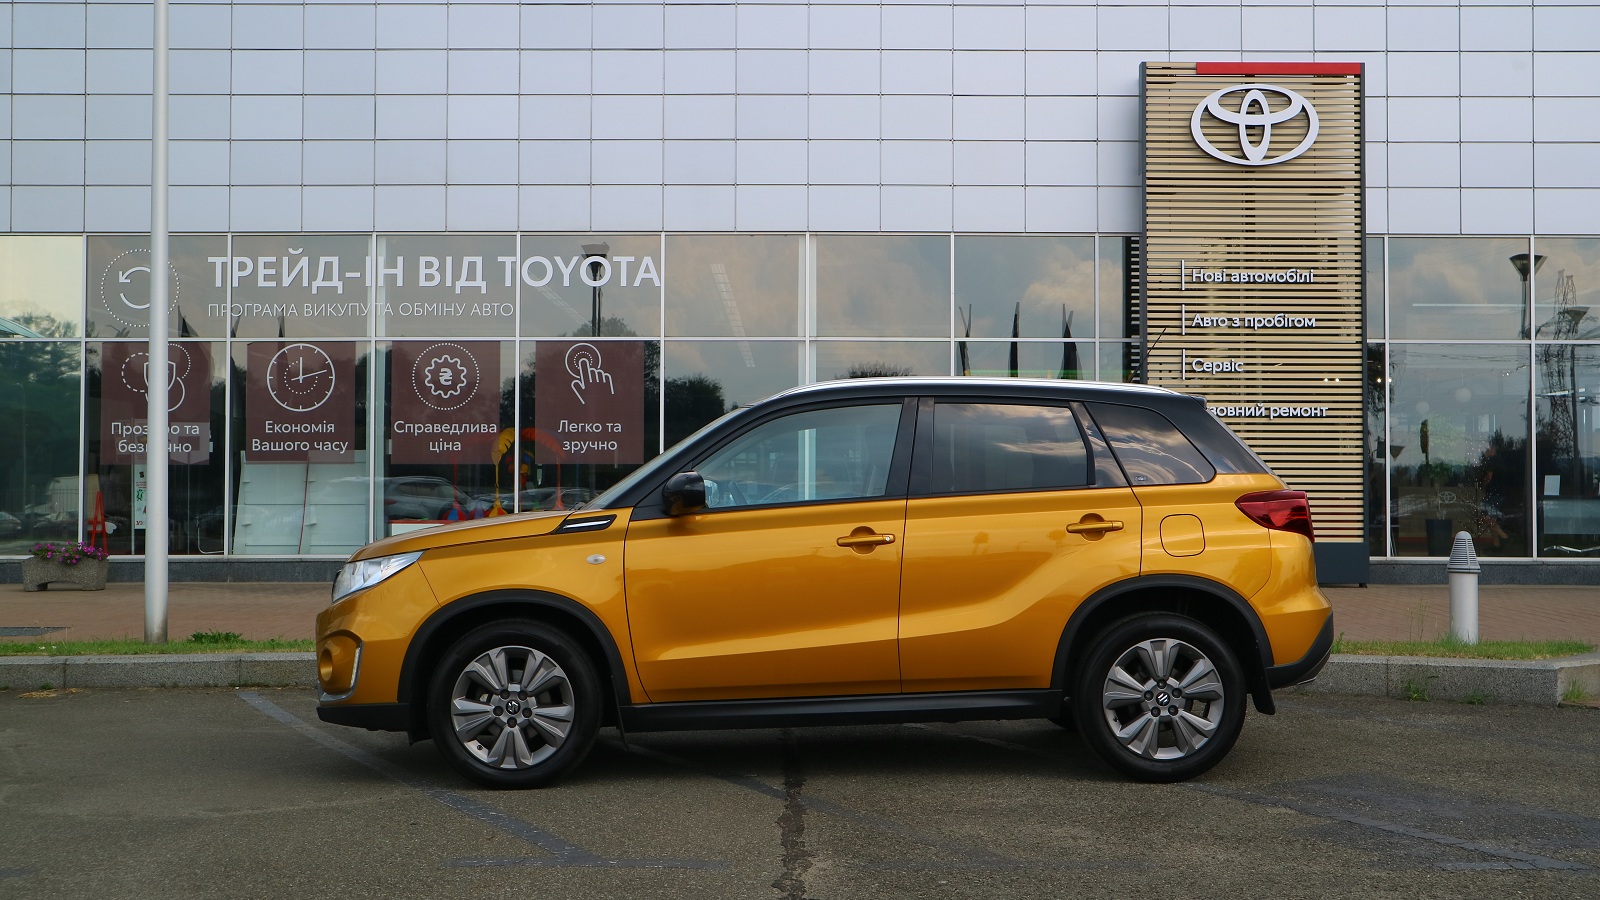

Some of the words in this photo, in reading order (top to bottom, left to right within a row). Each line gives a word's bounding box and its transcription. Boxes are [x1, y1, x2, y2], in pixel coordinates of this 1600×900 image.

[207, 248, 403, 294] ТРЕЙД-ІН
[418, 255, 487, 294] ВІД
[497, 255, 661, 288] TOYOTA
[1192, 269, 1227, 283] Нові
[1231, 269, 1314, 283] автомобілі
[208, 303, 299, 317] ПРОГРАМА
[303, 302, 371, 316] ВИКУПУ
[374, 302, 394, 316] ТА
[399, 302, 466, 316] ОБМІНУ
[470, 302, 514, 316] АВТО
[1192, 314, 1228, 328] Авто
[1232, 317, 1241, 328] з
[1244, 314, 1316, 330] пробігом
[1192, 358, 1244, 374] Сервіс
[1207, 403, 1266, 417] зовний
[1270, 406, 1329, 420] ремонт
[111, 422, 180, 438] Прозо
[183, 425, 200, 435] та
[264, 420, 335, 433] Економія
[393, 420, 497, 436] Справедлива
[557, 420, 602, 433] Легко
[606, 423, 622, 433] та
[118, 440, 192, 453] безно
[252, 439, 310, 451] Вашого
[314, 441, 349, 454] часу
[429, 440, 462, 453] ціна
[562, 441, 618, 454] зручно
